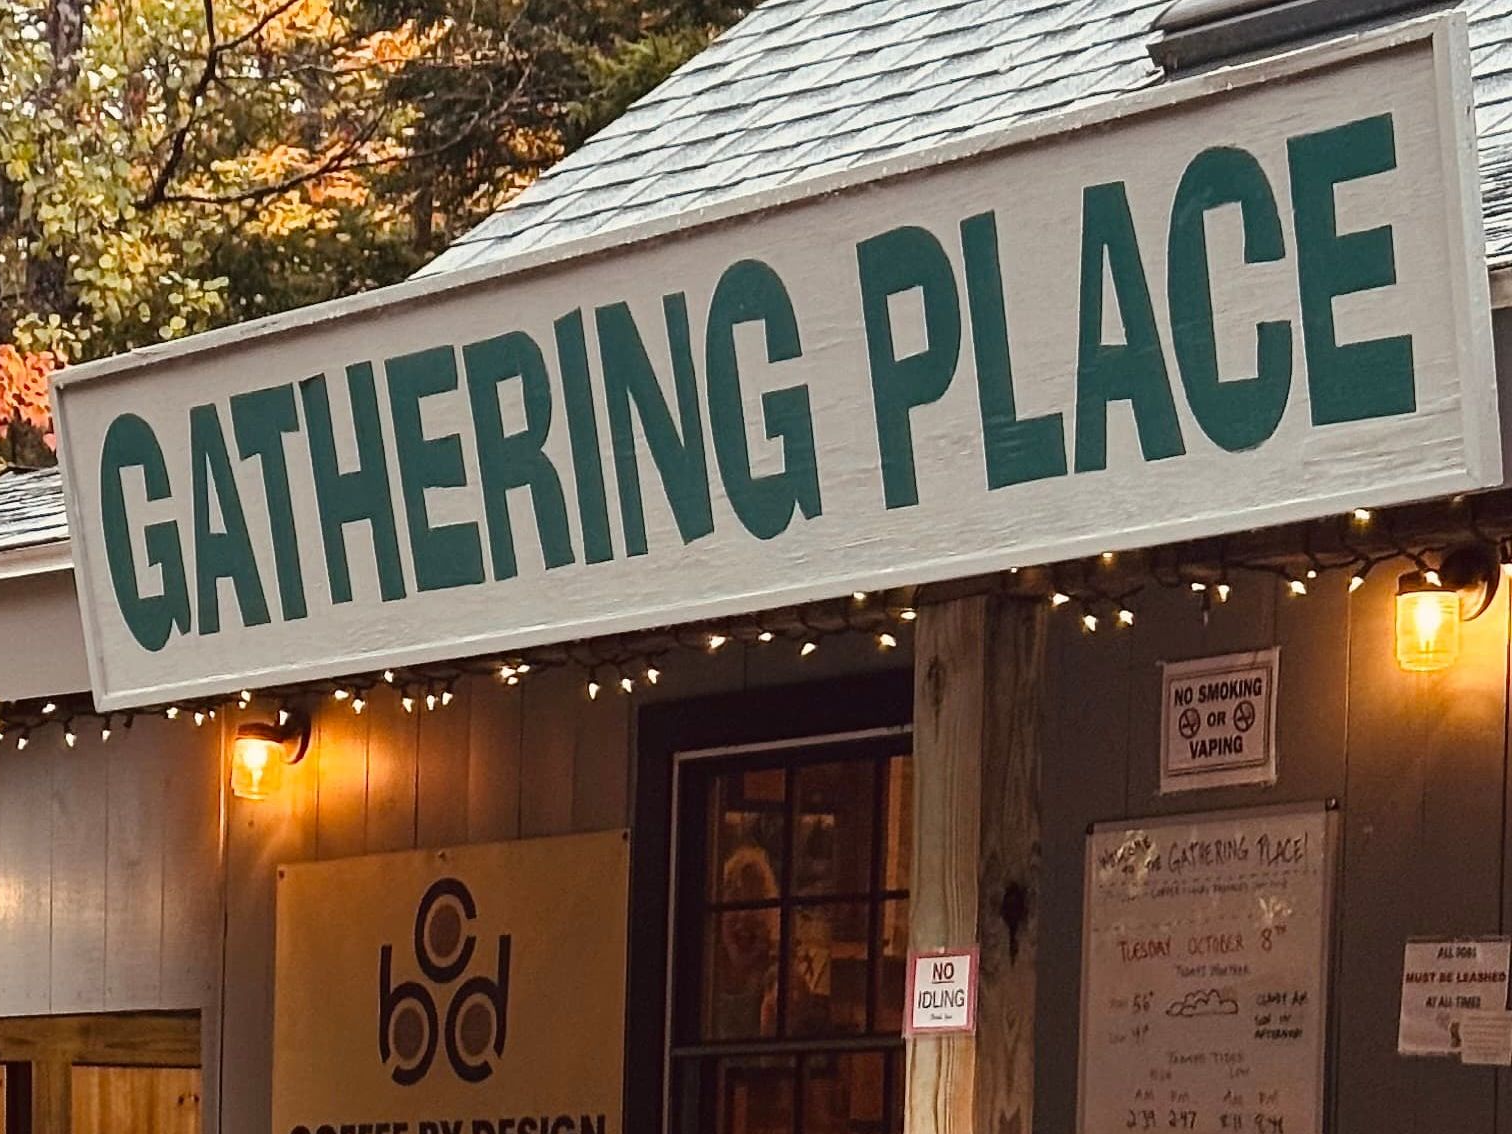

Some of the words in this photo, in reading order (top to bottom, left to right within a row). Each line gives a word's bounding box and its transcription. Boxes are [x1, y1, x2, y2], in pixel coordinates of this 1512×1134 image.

[99, 257, 824, 653] GATHERING
[854, 112, 1417, 511] PLACE
[1174, 687, 1193, 706] NO
[1199, 677, 1262, 703] SMOKING
[1207, 711, 1226, 727] OR
[1189, 735, 1243, 759] VAPING
[1168, 836, 1249, 873] GATHERING
[1119, 934, 1172, 962] TUESDAY
[1189, 934, 1244, 955] OCTOBER
[932, 962, 954, 980] NO
[1405, 972, 1435, 983] MUST
[1439, 972, 1452, 983] BE
[1456, 971, 1506, 983] LEASHED
[917, 989, 965, 1009] IDLING
